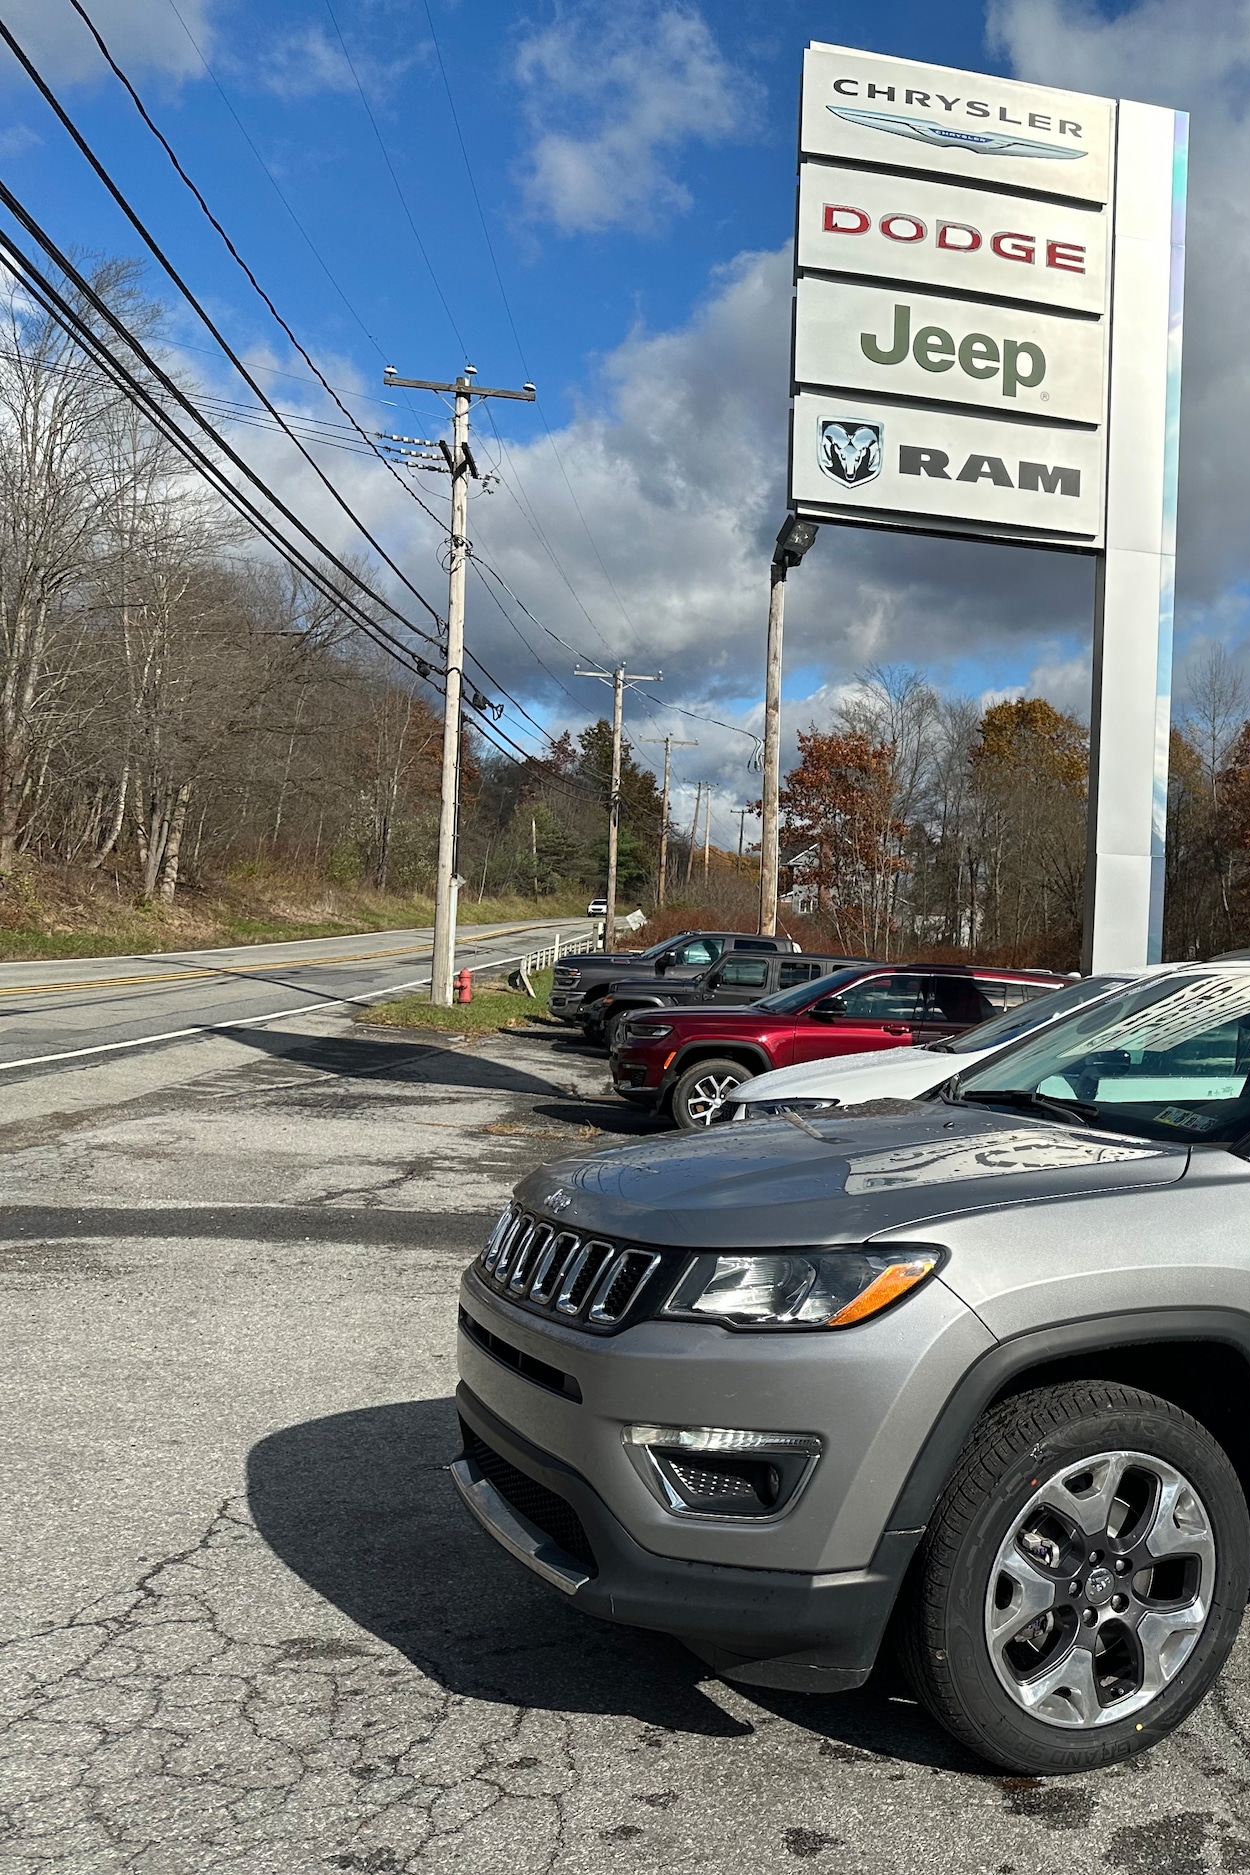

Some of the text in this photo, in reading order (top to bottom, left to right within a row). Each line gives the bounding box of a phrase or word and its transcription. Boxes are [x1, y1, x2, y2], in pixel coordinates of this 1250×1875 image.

[833, 79, 1084, 138] CHRYSLER
[934, 130, 987, 142] CHRYSLER
[822, 203, 1087, 274] DODGE
[860, 304, 1046, 397] Jeep
[899, 445, 1081, 497] RAM
